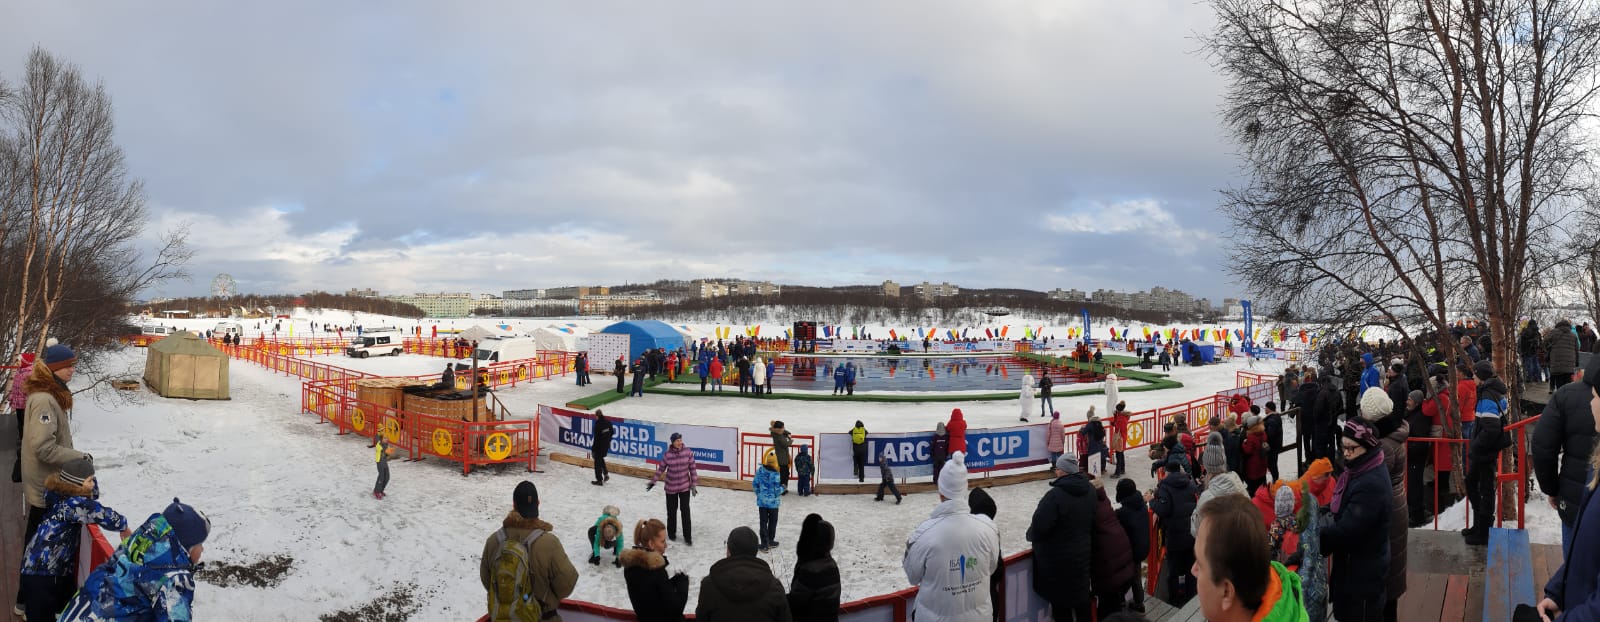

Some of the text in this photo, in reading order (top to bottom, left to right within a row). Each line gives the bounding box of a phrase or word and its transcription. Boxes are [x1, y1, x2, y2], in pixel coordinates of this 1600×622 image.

[564, 430, 663, 458] CHAMONSHIP
[611, 424, 650, 442] ORLD
[977, 435, 1023, 457] CUP
